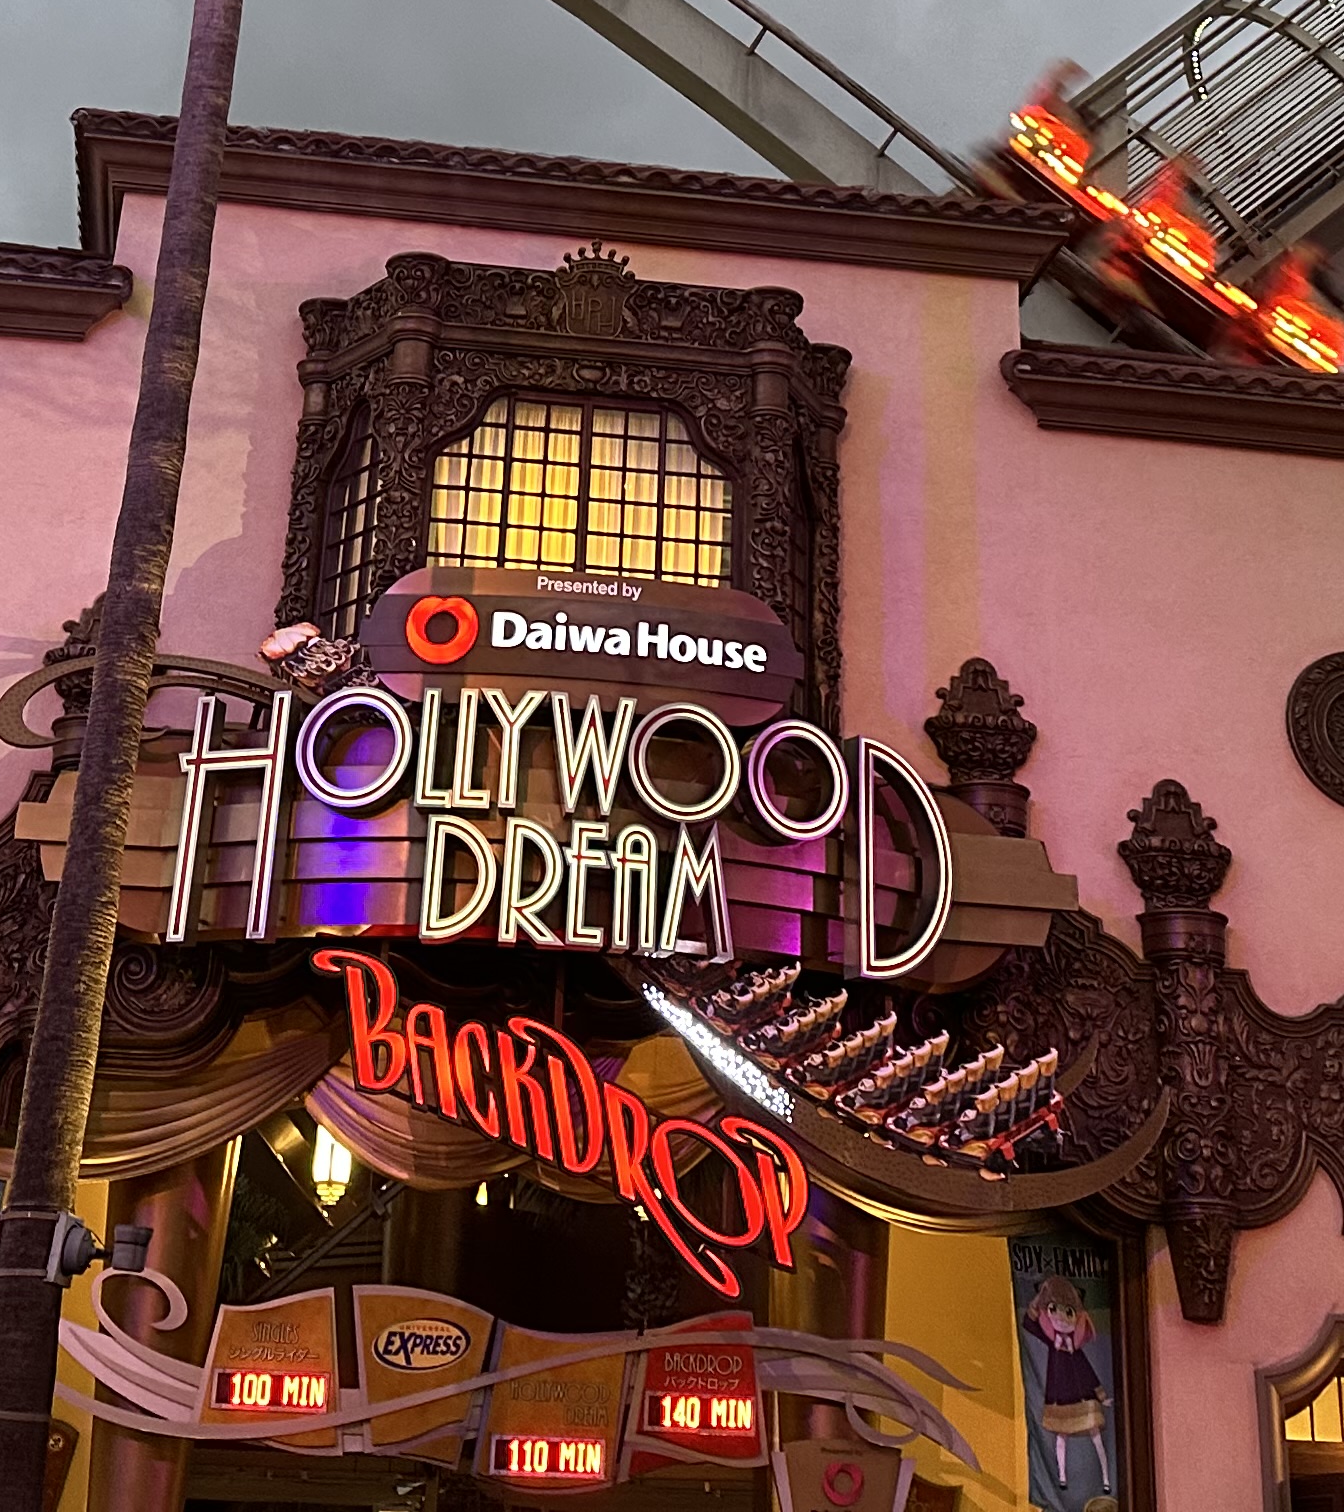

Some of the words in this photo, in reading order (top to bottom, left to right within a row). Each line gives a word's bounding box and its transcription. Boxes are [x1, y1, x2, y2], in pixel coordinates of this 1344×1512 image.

[537, 576, 618, 596] Presented
[622, 582, 642, 601] by
[491, 611, 630, 656] Daiwa
[636, 621, 767, 673] House
[166, 687, 953, 980] HOLLYWOOD
[421, 814, 733, 961] DREAM
[312, 948, 810, 1299] BACKDROP
[252, 1322, 300, 1344] SINGLES
[382, 1331, 463, 1366] EXPRESS
[229, 1345, 320, 1363] シングルライダー
[664, 1352, 743, 1375] BACKDROP
[231, 1372, 273, 1406] 100
[282, 1375, 326, 1408] MIN
[663, 1376, 740, 1391] バックドロップ
[660, 1395, 700, 1429] 140
[710, 1397, 752, 1429] MIN
[508, 1440, 549, 1473] 110
[558, 1442, 601, 1474] MIN
